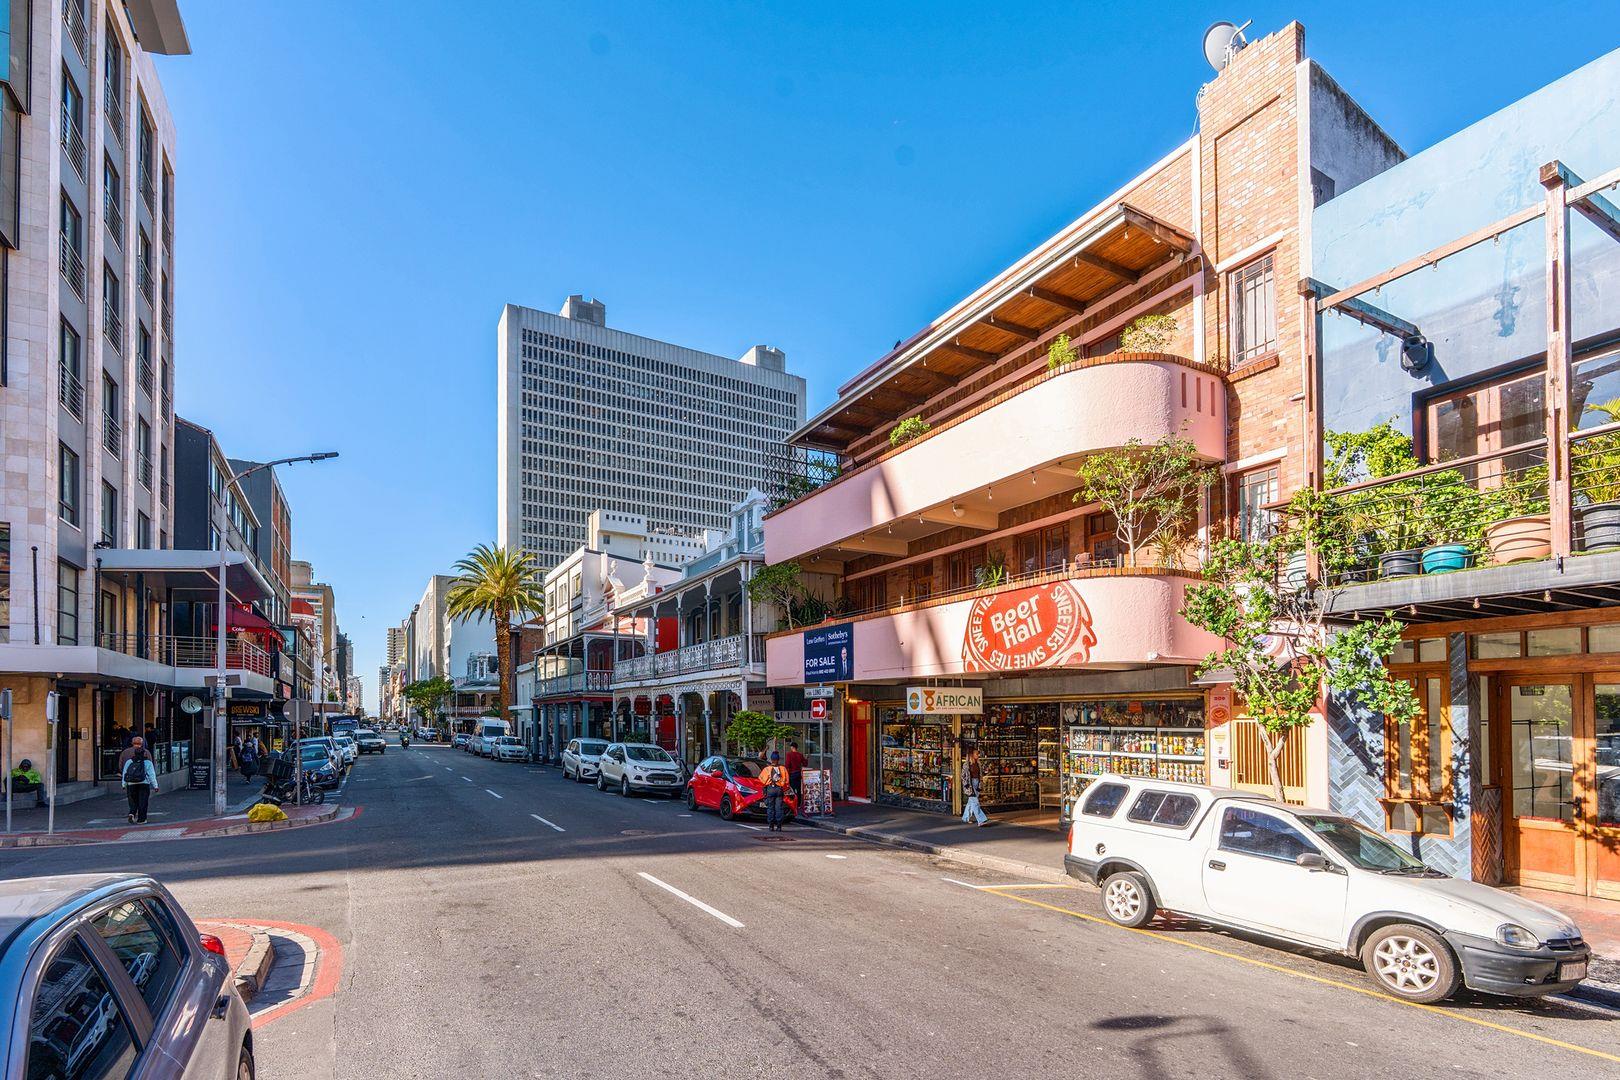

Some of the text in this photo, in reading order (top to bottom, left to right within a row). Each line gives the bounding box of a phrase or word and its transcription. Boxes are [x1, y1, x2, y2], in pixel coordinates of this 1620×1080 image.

[990, 594, 1040, 634] Beer
[1046, 585, 1073, 651] SWEETIES
[827, 630, 849, 640] Sotheby's
[1001, 613, 1043, 650] Hall
[805, 656, 836, 668] FOR SALE
[989, 646, 1047, 670] SWEETIES
[936, 694, 981, 707] AFRICAN
